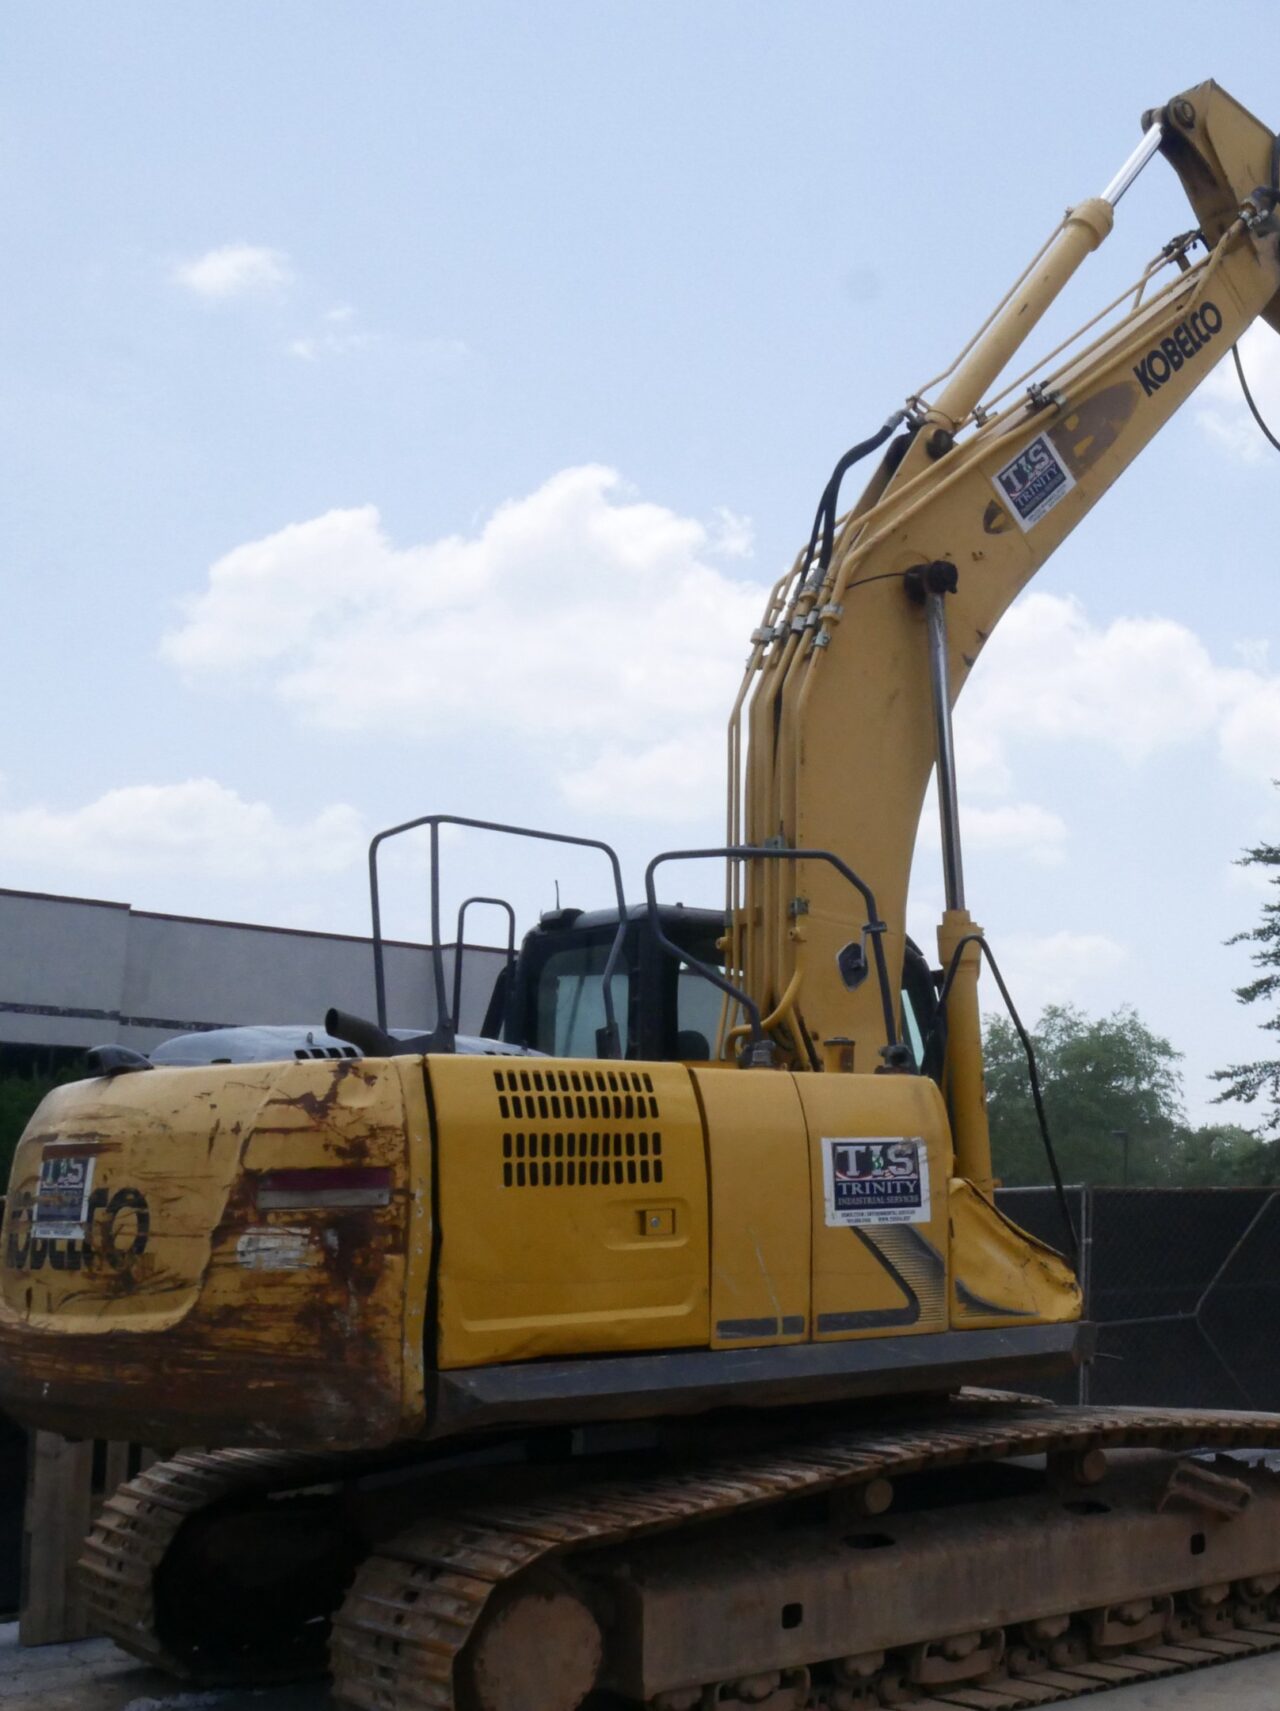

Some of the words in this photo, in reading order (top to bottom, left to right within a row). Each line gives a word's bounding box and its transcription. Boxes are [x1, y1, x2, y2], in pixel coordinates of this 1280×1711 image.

[1132, 301, 1222, 397] KOBELCO
[1001, 443, 1050, 492] TIS
[1015, 464, 1058, 506] TRINITY
[836, 1144, 914, 1176] TIS
[837, 1180, 918, 1196] TRINITY
